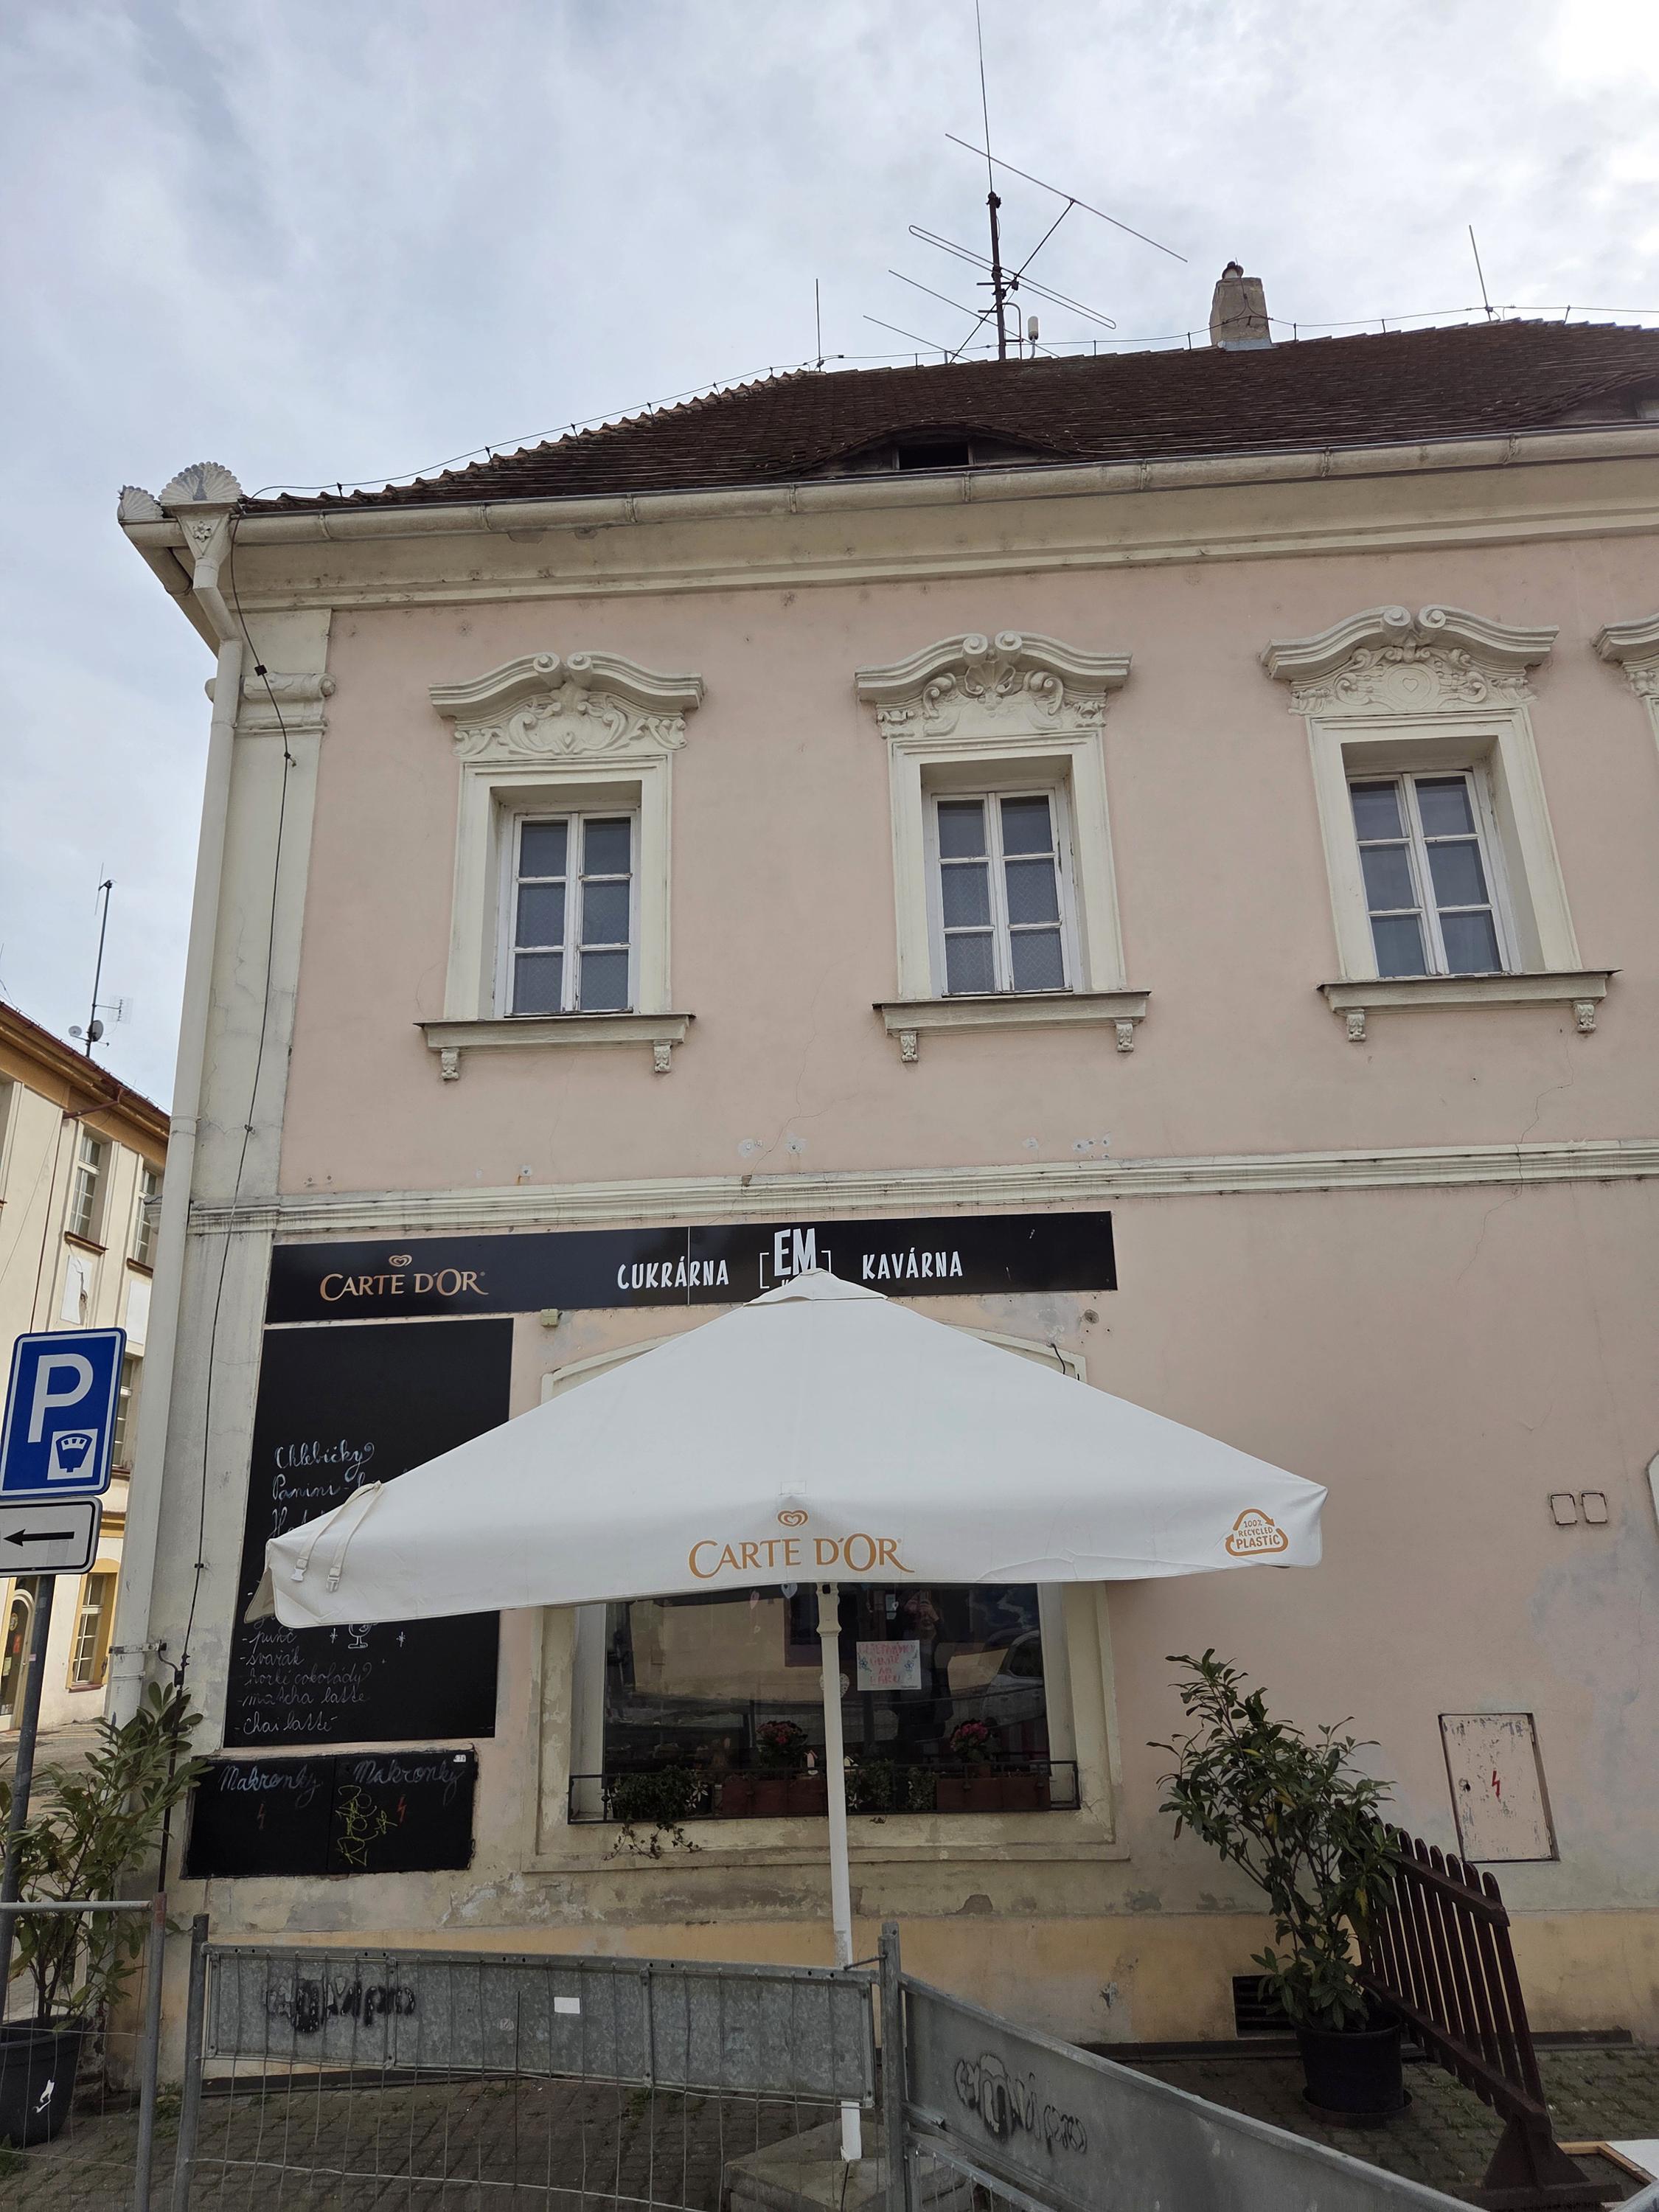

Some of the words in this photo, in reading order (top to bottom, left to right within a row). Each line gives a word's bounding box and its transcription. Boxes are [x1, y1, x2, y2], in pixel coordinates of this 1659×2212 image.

[774, 1228, 817, 1277] EM
[862, 1248, 964, 1281] KAVÁRNA
[319, 1273, 405, 1302] CARTE
[616, 1256, 729, 1290] CUKRÁRNA
[27, 1353, 94, 1443] P
[1238, 1526, 1273, 1537] RECYCLED
[1243, 1519, 1263, 1528] 100%
[688, 1540, 802, 1579] CARTE
